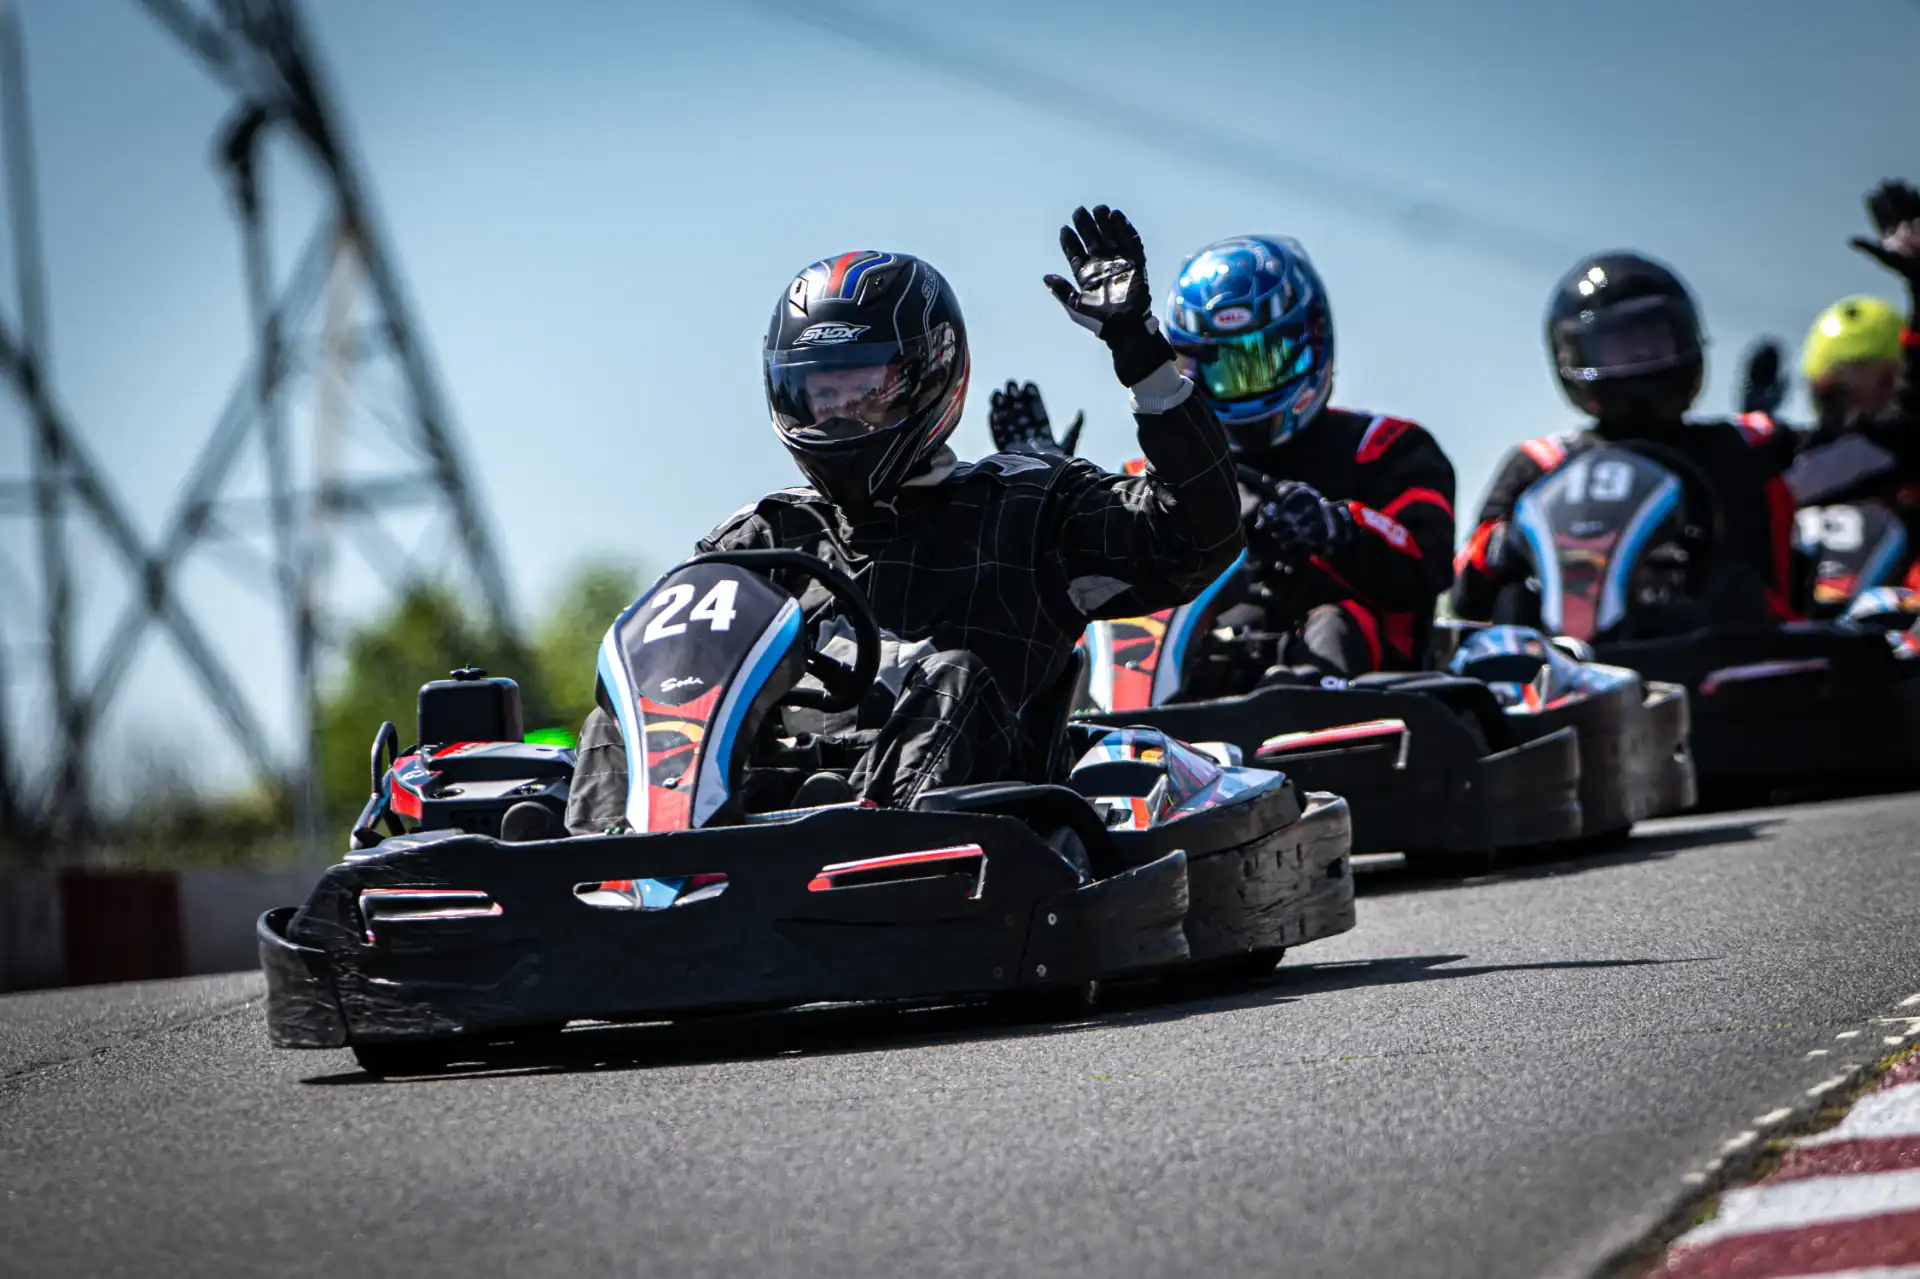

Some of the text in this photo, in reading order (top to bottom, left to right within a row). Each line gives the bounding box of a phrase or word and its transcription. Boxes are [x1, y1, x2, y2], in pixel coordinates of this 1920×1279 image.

[800, 327, 861, 341] SHOX
[1564, 461, 1634, 504] 19
[643, 579, 739, 644] 24
